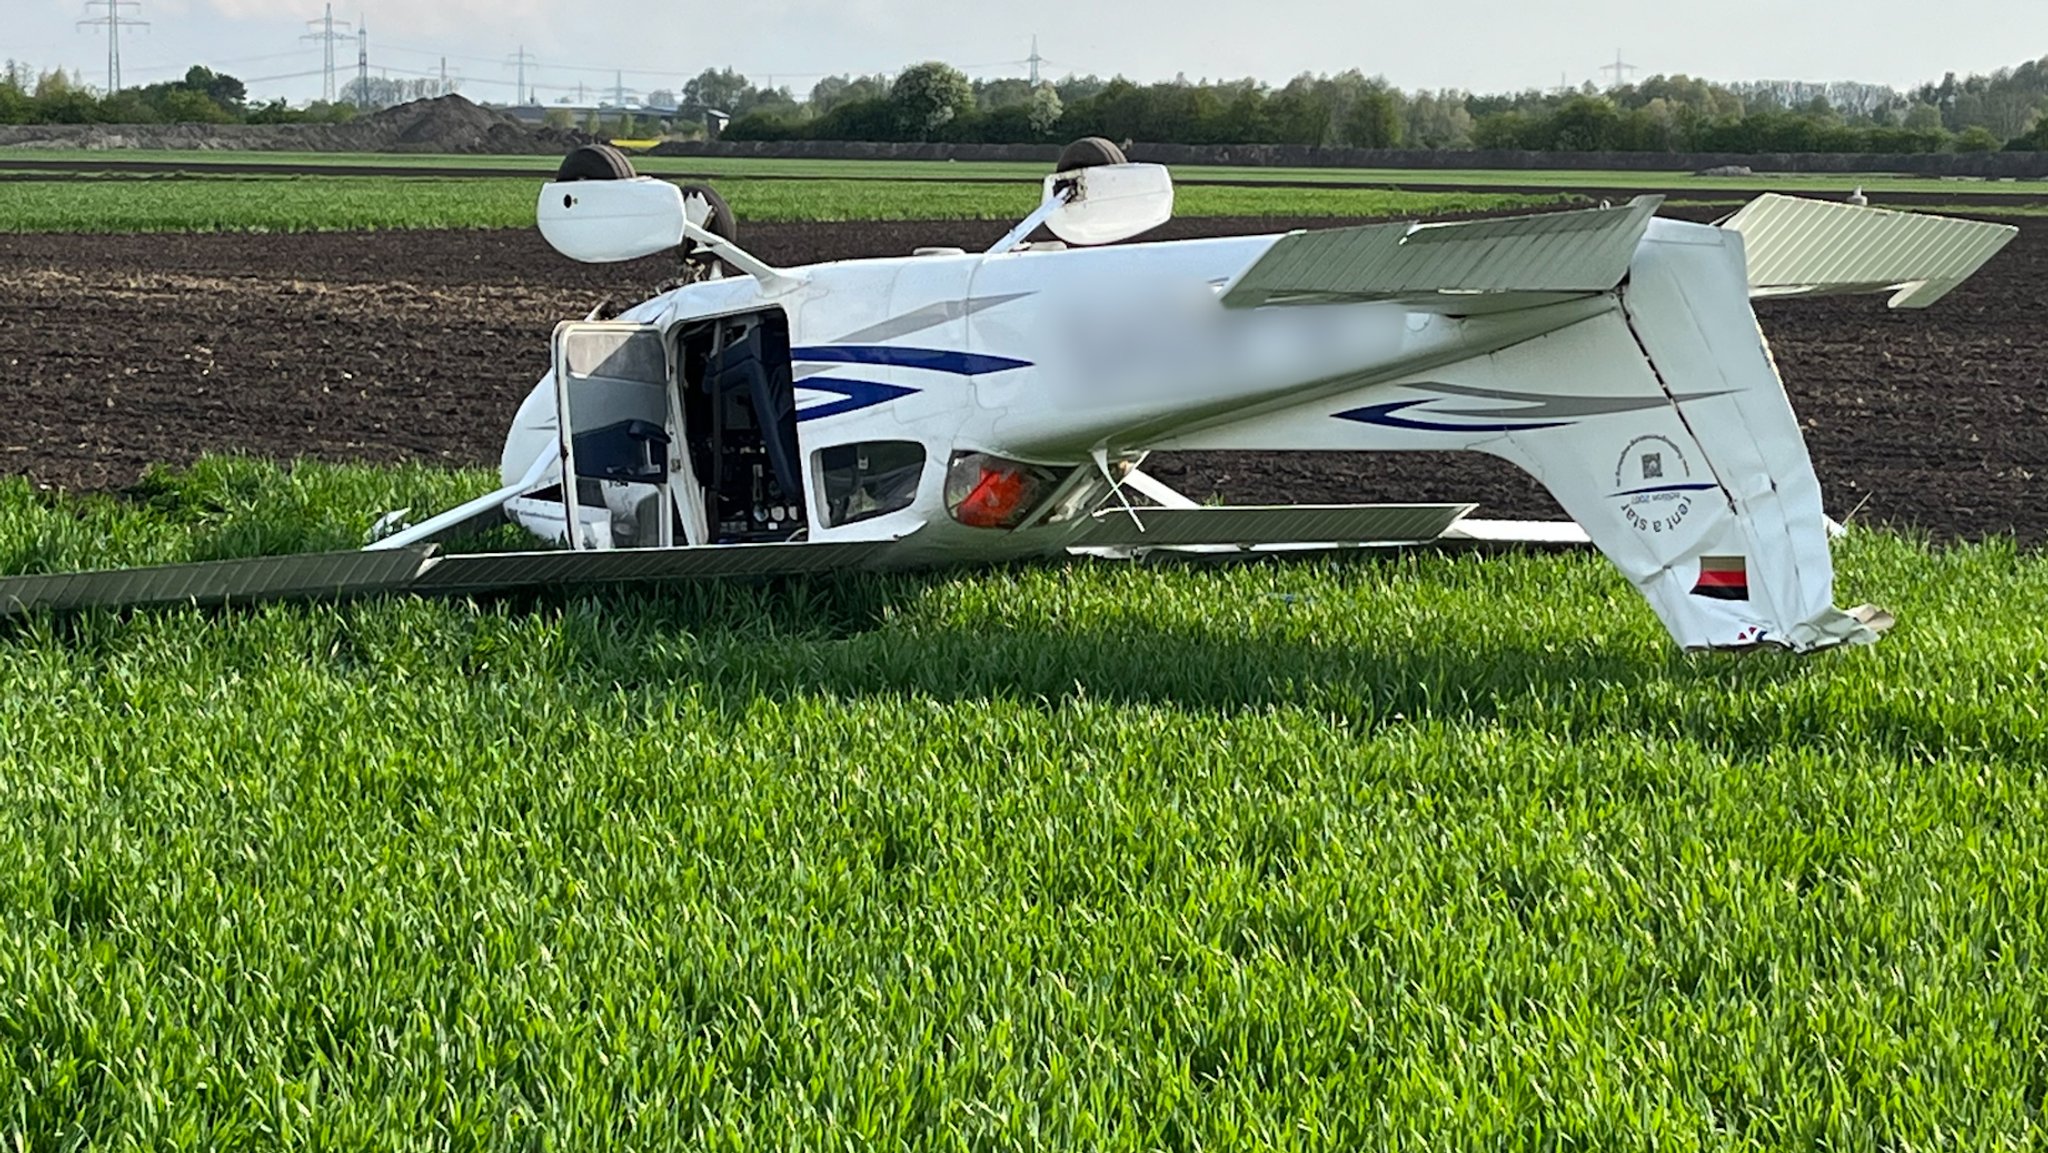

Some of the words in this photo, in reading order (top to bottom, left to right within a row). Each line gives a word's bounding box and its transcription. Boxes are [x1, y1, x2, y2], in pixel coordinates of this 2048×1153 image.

[1621, 503, 1648, 531] star
[1653, 520, 1661, 532] a
[1666, 496, 1691, 531] rent
